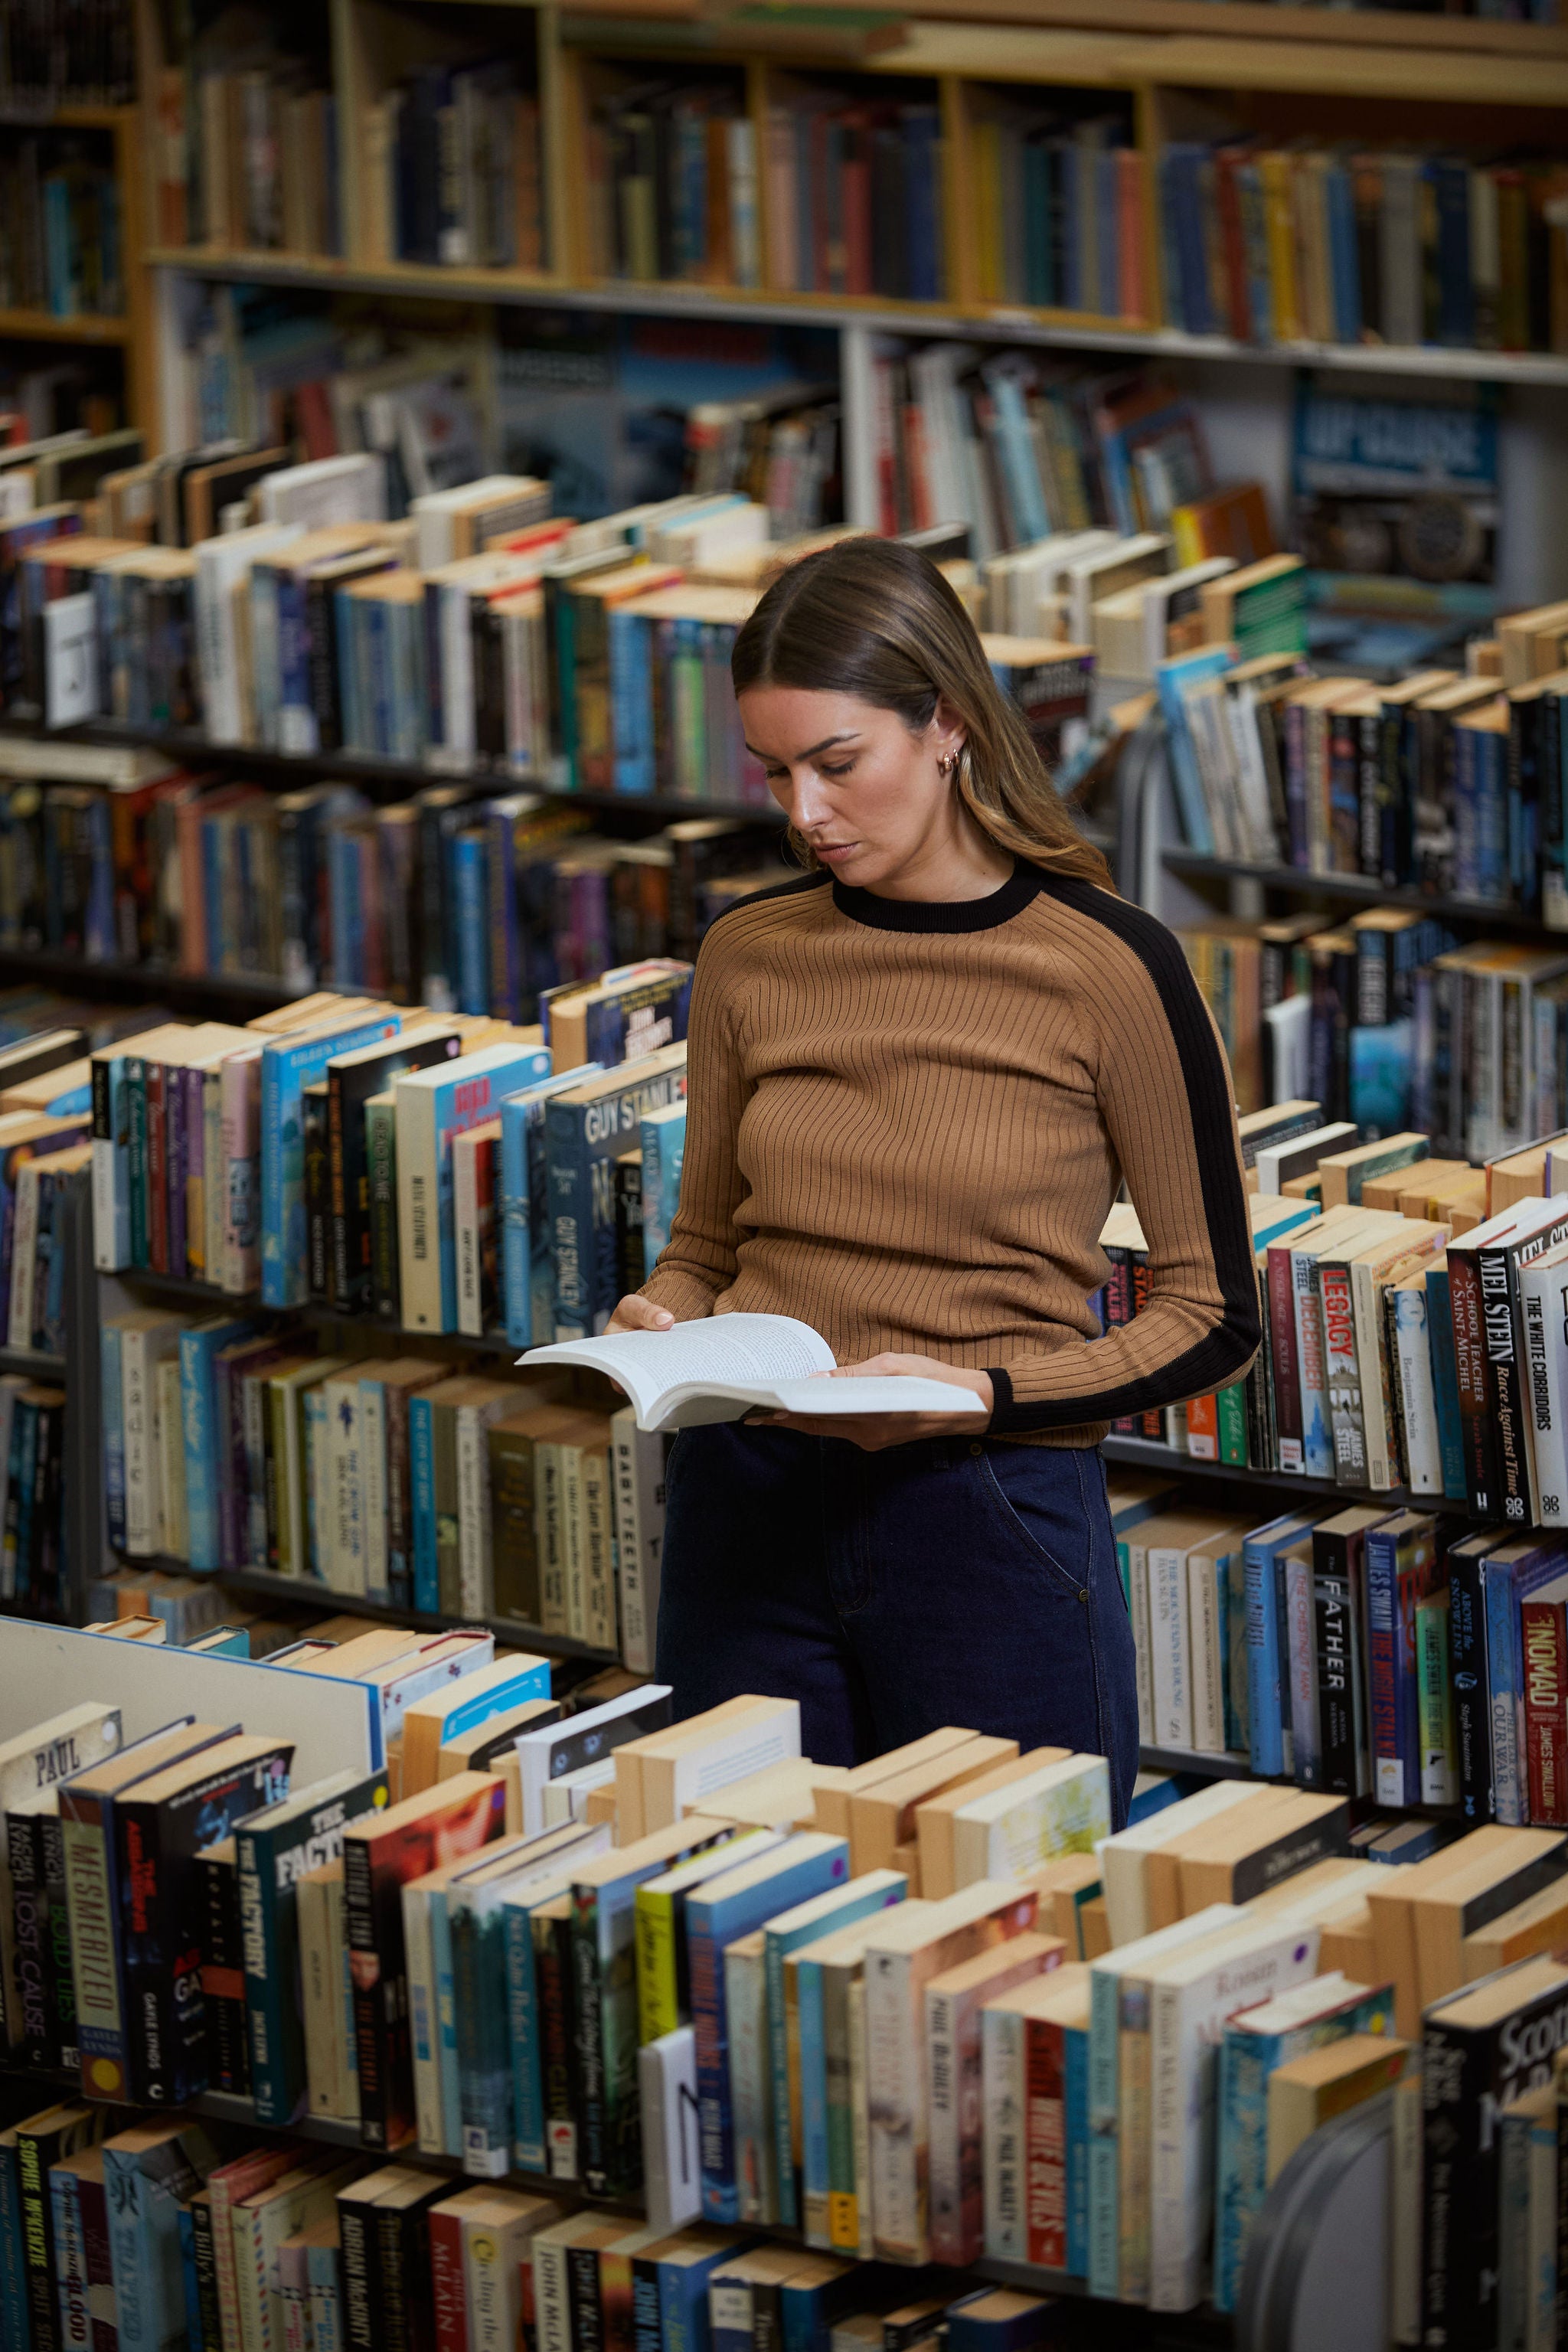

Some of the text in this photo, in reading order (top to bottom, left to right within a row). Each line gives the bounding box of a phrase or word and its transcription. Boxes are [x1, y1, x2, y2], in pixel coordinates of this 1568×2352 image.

[375, 1119, 390, 1201] DEAD TO ME
[585, 1098, 619, 1145] GUY
[557, 1216, 580, 1306] GUY STANLEY
[1295, 1259, 1308, 1289] STEEL
[1307, 1256, 1320, 1293] JAMES
[1301, 1295, 1324, 1391] DECEMBER
[1322, 1269, 1354, 1357] LEGACY
[1453, 1289, 1471, 1391] SAINT-MICHEL
[1465, 1266, 1485, 1402] The SCHOOL TEACHER
[1479, 1255, 1514, 1362] MEL STEIN
[1278, 1338, 1291, 1375] SOULS
[1527, 1295, 1551, 1430] THE WHITE CORRIDORS
[1403, 1357, 1418, 1439] Benjamin Stein
[1495, 1365, 1521, 1496] Race Against Time
[1337, 1428, 1350, 1464] STEEL
[1350, 1426, 1364, 1468] JAMES
[620, 1446, 637, 1590] BABY TEETH
[1368, 1541, 1393, 1630] JAMES SWAIN
[1451, 1577, 1463, 1660] SNOWLINE
[1462, 1591, 1473, 1650] ABOVE the
[1297, 1575, 1312, 1702] THE CHESTNUT MAN
[1323, 1580, 1345, 1690] FATHER
[1425, 1628, 1439, 1695] JAMES SWAIN
[1528, 1630, 1558, 1707] NOMAD
[1372, 1632, 1396, 1760] THE NIGHT STALKE
[1428, 1701, 1445, 1749] THE NIGHT
[35, 1736, 80, 1788] PAUL
[1460, 1703, 1474, 1782] Steph Swainston
[1493, 1704, 1511, 1785] OUR WAR
[1540, 1725, 1556, 1808] JAMES SWALLOW
[8, 1822, 25, 1883] LYNCH
[309, 1801, 345, 1837] THE
[70, 1842, 115, 2011] MESMERIZED
[238, 1837, 268, 1981] THE FACTORY
[14, 1890, 47, 2038] LOST CAUSE
[48, 1903, 77, 2023] BOLD LIES
[142, 1991, 163, 2070] GAYLE LYNDS
[511, 1989, 531, 2043] Perfect
[1029, 2097, 1065, 2159] WHITE
[18, 2138, 48, 2269] SOPHIE McKENZIE
[1029, 2161, 1067, 2233] DEVILS
[30, 2274, 51, 2315] SPLIT
[194, 2230, 215, 2284] Billy's
[341, 2213, 373, 2348] ADRIAN McKINTY
[433, 2241, 456, 2333] McLAIN
[572, 2252, 596, 2300] JOHN
[67, 2275, 86, 2341] BLOOD
[540, 2251, 562, 2352] JOHN McLA
[634, 2275, 658, 2327] JOHN
